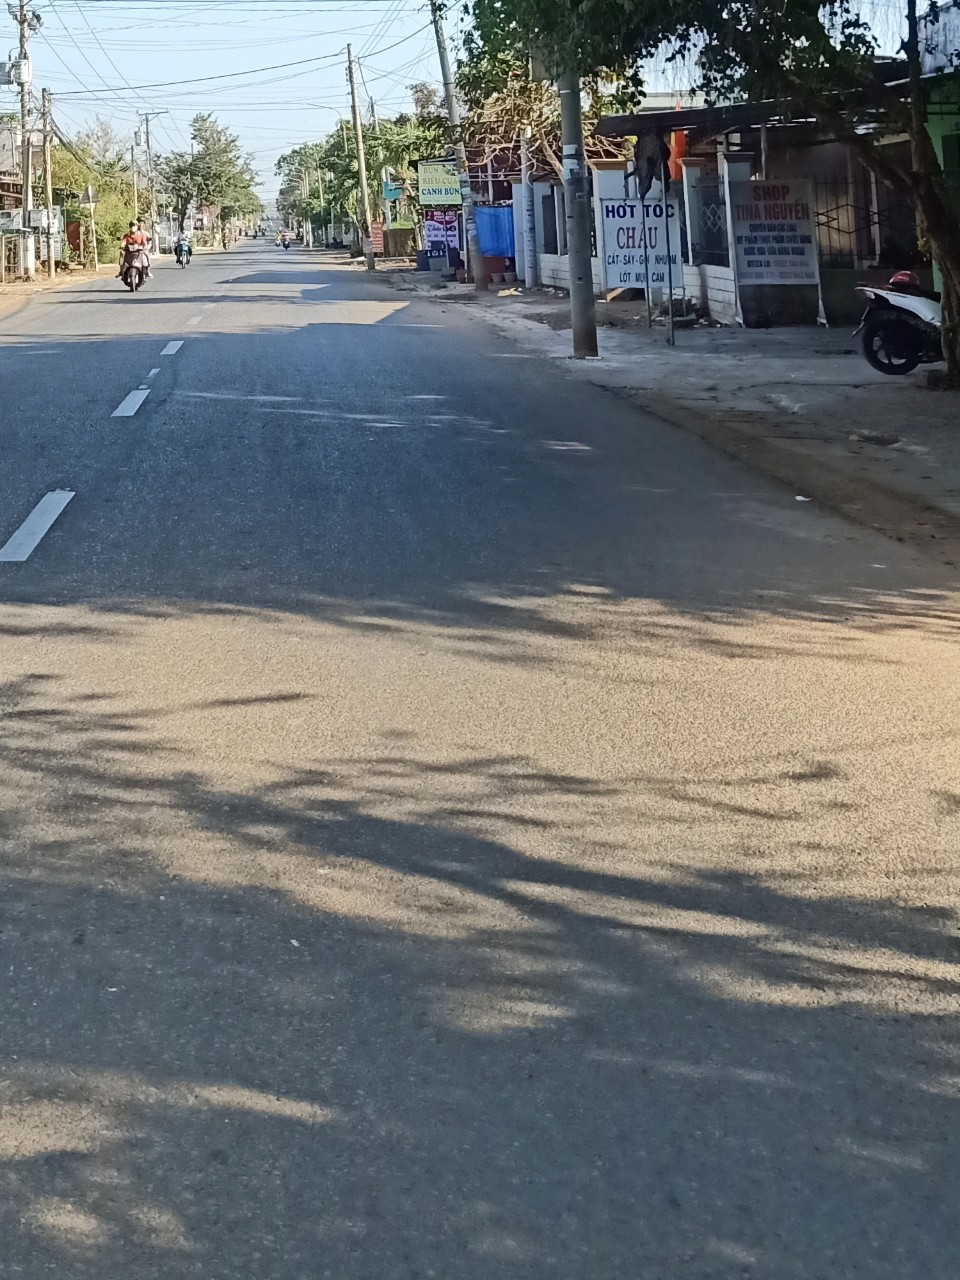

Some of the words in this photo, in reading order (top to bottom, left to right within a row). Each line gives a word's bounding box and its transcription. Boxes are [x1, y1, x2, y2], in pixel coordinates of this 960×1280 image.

[421, 187, 443, 196] CANH
[752, 185, 790, 202] SHOP
[605, 200, 637, 219] HỚT
[734, 202, 761, 221] TINA
